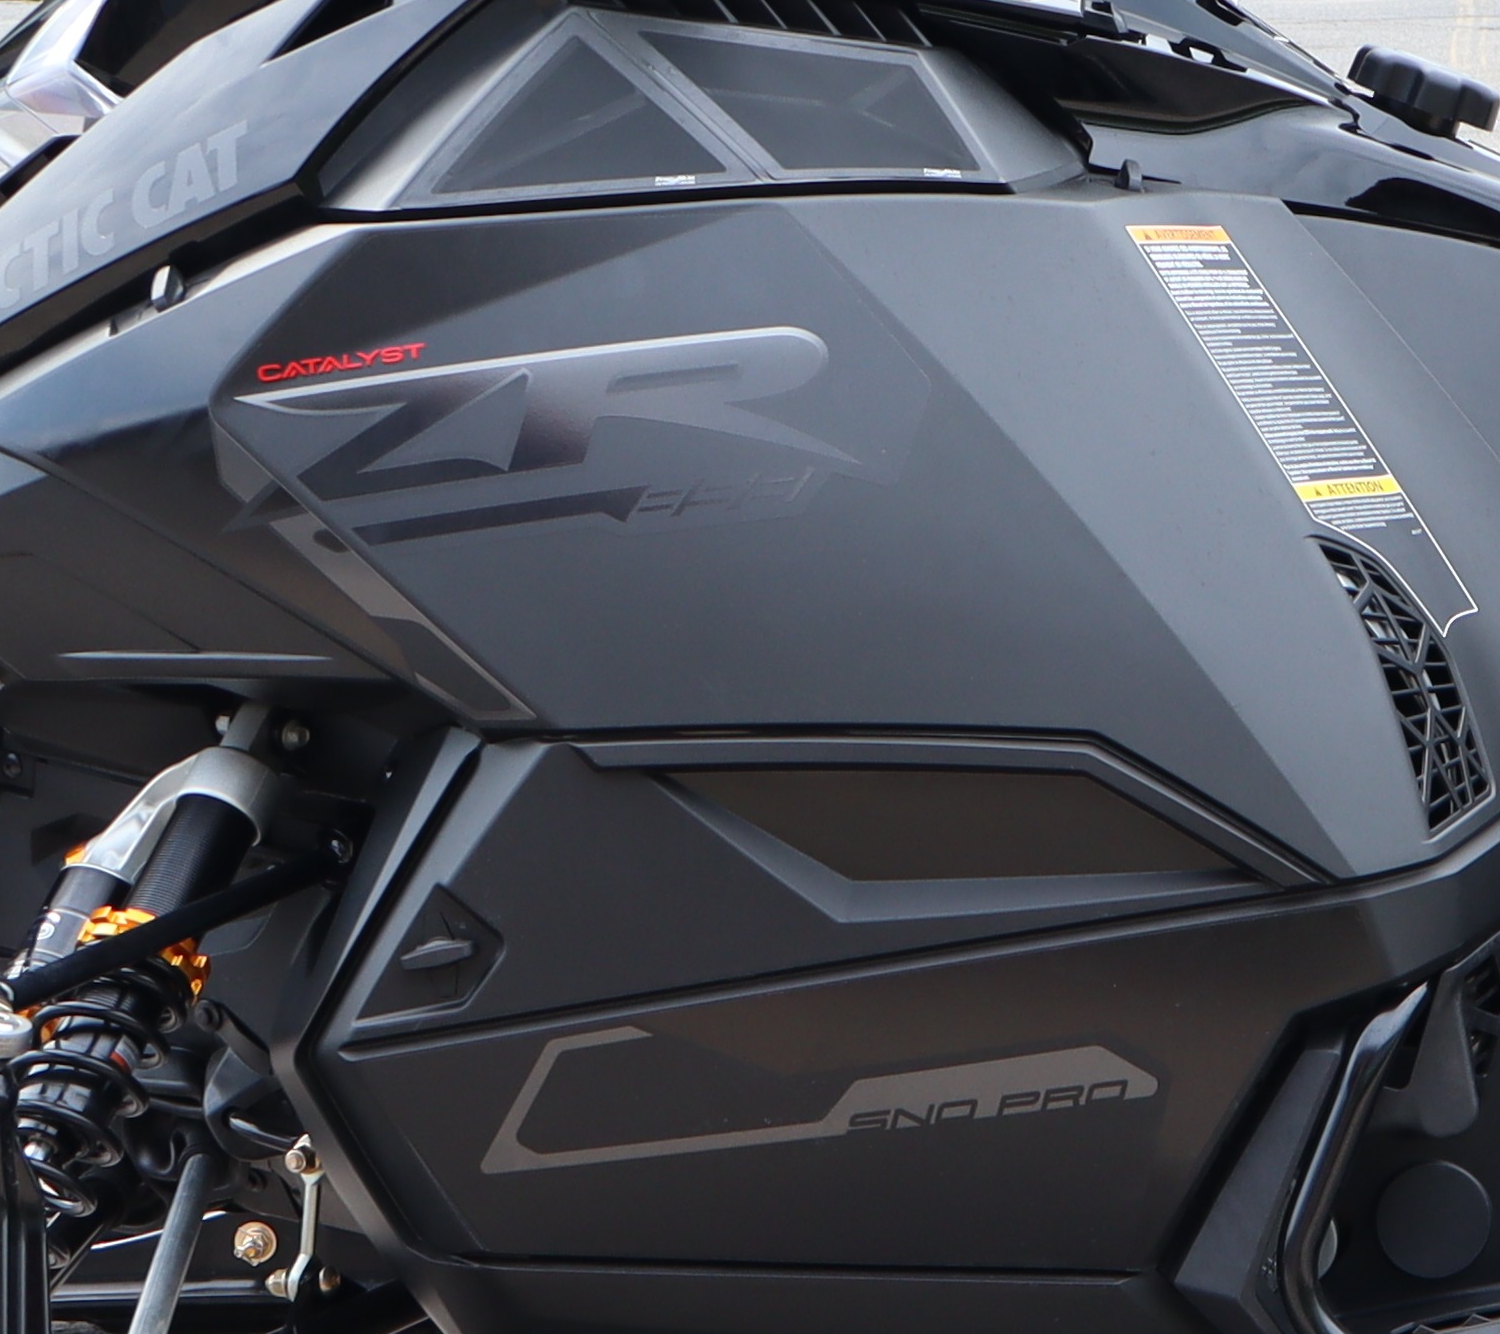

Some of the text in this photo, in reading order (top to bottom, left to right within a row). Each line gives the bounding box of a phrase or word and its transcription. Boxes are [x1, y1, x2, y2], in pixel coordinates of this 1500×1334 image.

[130, 120, 250, 231] CAT
[256, 342, 426, 384] CATALYST
[1326, 480, 1385, 497] ATTENTION
[847, 1079, 1130, 1133] SNO PRO
